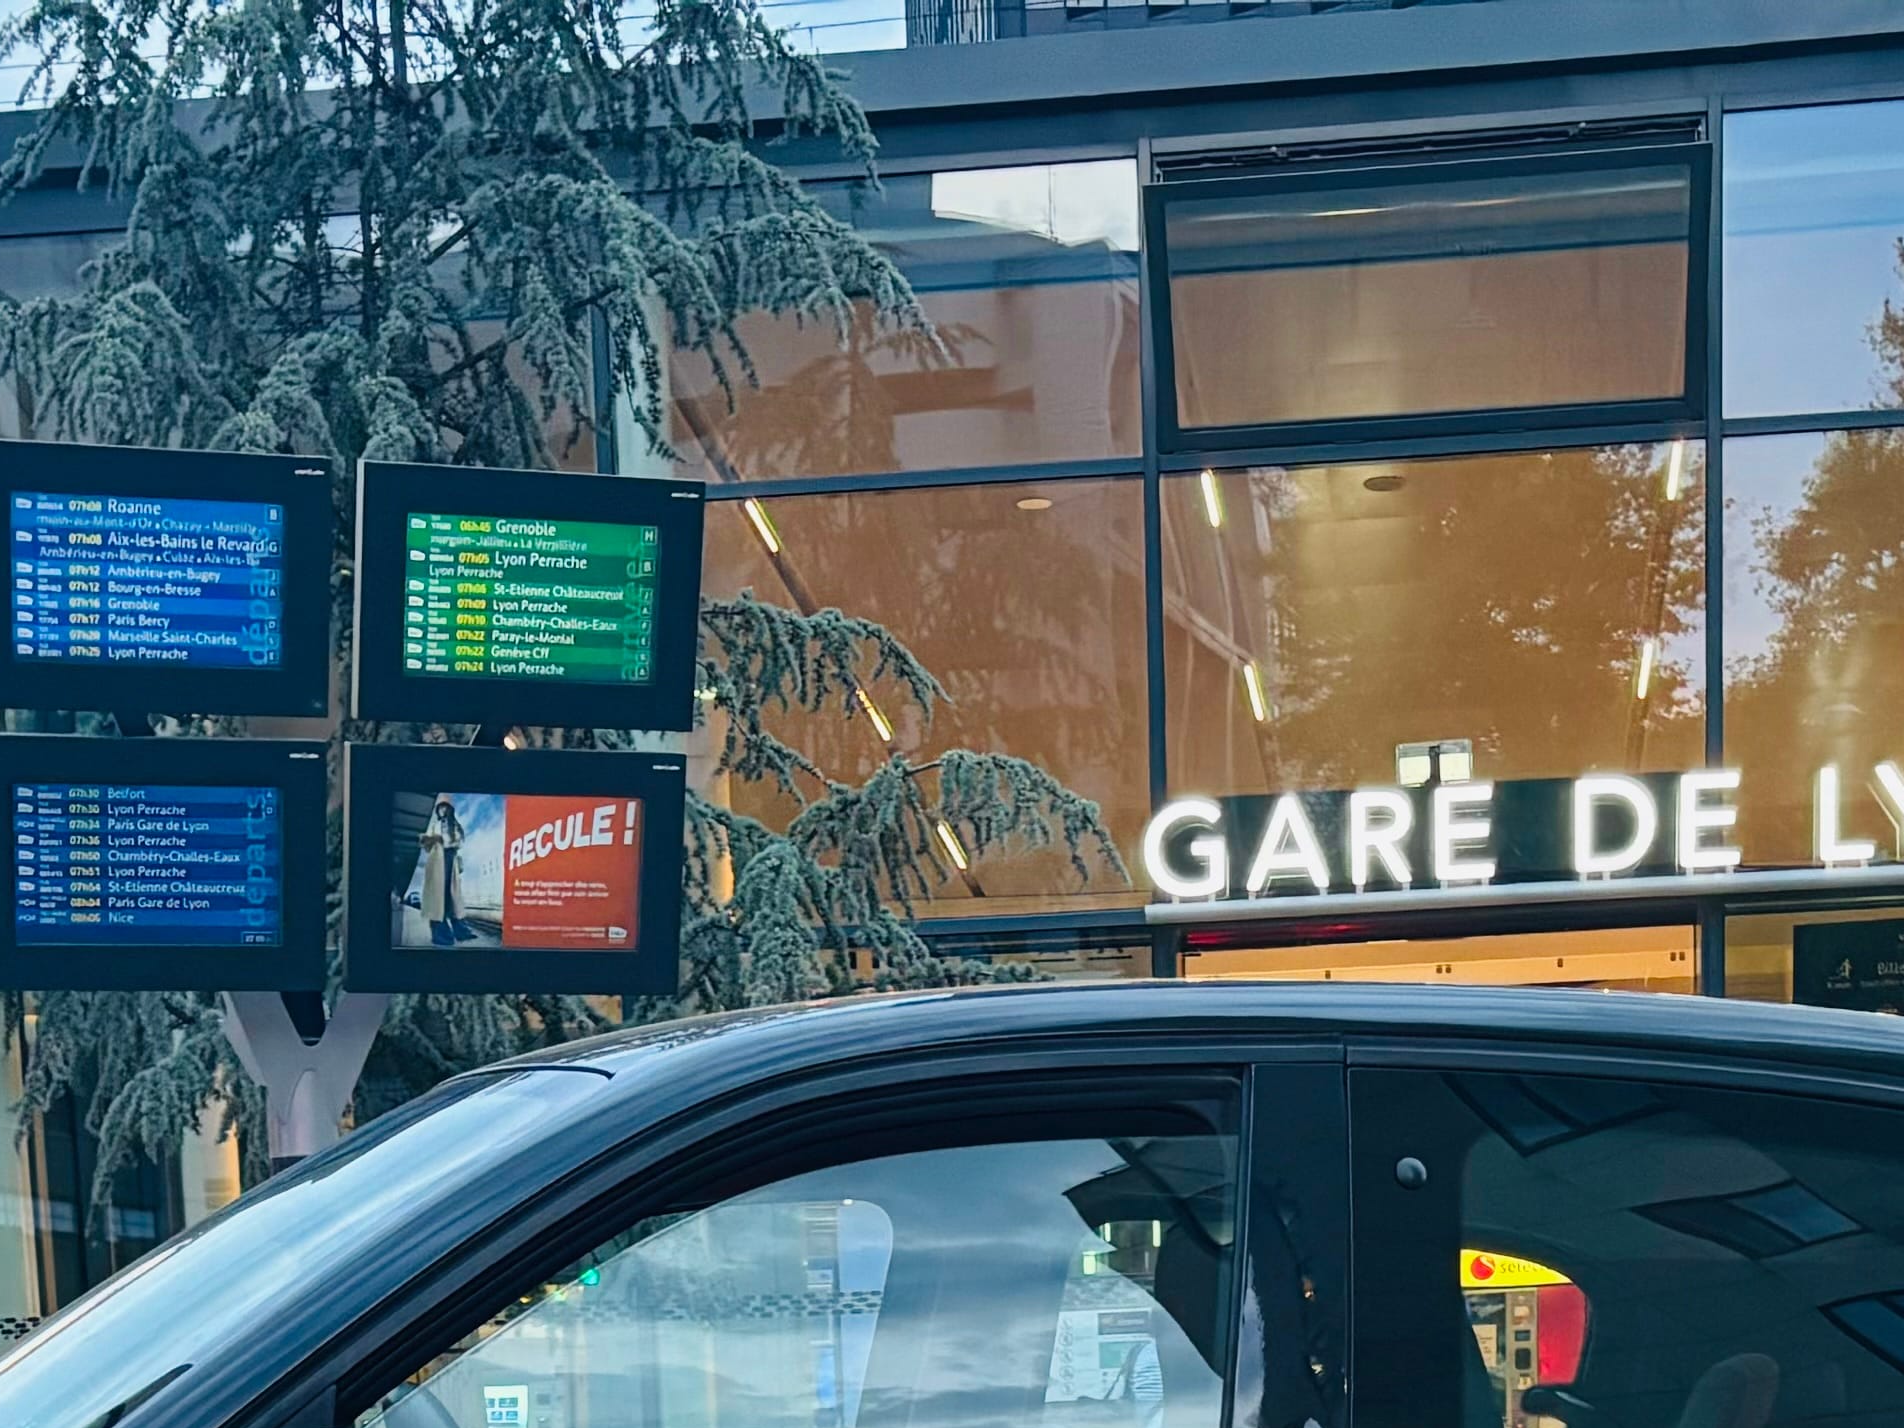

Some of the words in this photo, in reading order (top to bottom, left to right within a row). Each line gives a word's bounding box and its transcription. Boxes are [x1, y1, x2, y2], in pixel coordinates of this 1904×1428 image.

[107, 498, 162, 516] Roanne
[495, 518, 557, 537] Grenoble
[107, 531, 198, 549] Aix-les-Bains
[200, 536, 214, 551] le
[217, 537, 265, 553] Revard
[495, 550, 526, 568] Lyon
[529, 552, 588, 570] Perrache
[107, 564, 221, 584] Ambérieu-en-Bugey
[428, 564, 455, 578] Lyon
[457, 565, 504, 579] Perrache
[107, 581, 202, 597] Bourg-en-Bresse
[493, 582, 551, 597] St-Etienne
[107, 597, 160, 612] Grenoble
[492, 599, 519, 613] Lyon
[521, 599, 568, 614] Perrache
[107, 613, 136, 627] Paris
[138, 614, 170, 630] Bercy
[107, 629, 160, 643] Marseille
[161, 630, 238, 647] Saint-Charles
[107, 646, 136, 660] Lyon
[138, 646, 189, 661] Perrache
[490, 645, 531, 659] Genève
[490, 661, 517, 675] Lyon
[518, 661, 565, 676] Perrache
[107, 803, 135, 817] Lyon
[137, 803, 186, 816] Perrache
[107, 819, 135, 831] Paris
[137, 819, 164, 831] Gare
[165, 820, 180, 831] de
[182, 821, 209, 834] Lyon
[1142, 784, 1497, 899] GARE
[1572, 767, 1744, 875] DE
[107, 834, 135, 848] Lyon
[137, 835, 187, 847] Perrache
[508, 804, 617, 871] RECULE
[623, 801, 637, 845] !
[107, 865, 135, 879] Lyon
[137, 865, 187, 878] Perrache
[107, 881, 169, 893] St-Etienne
[107, 897, 136, 909] Paris
[137, 897, 164, 909] Gare
[166, 898, 180, 909] de
[182, 898, 210, 910] Lyon
[108, 912, 135, 924] Nice
